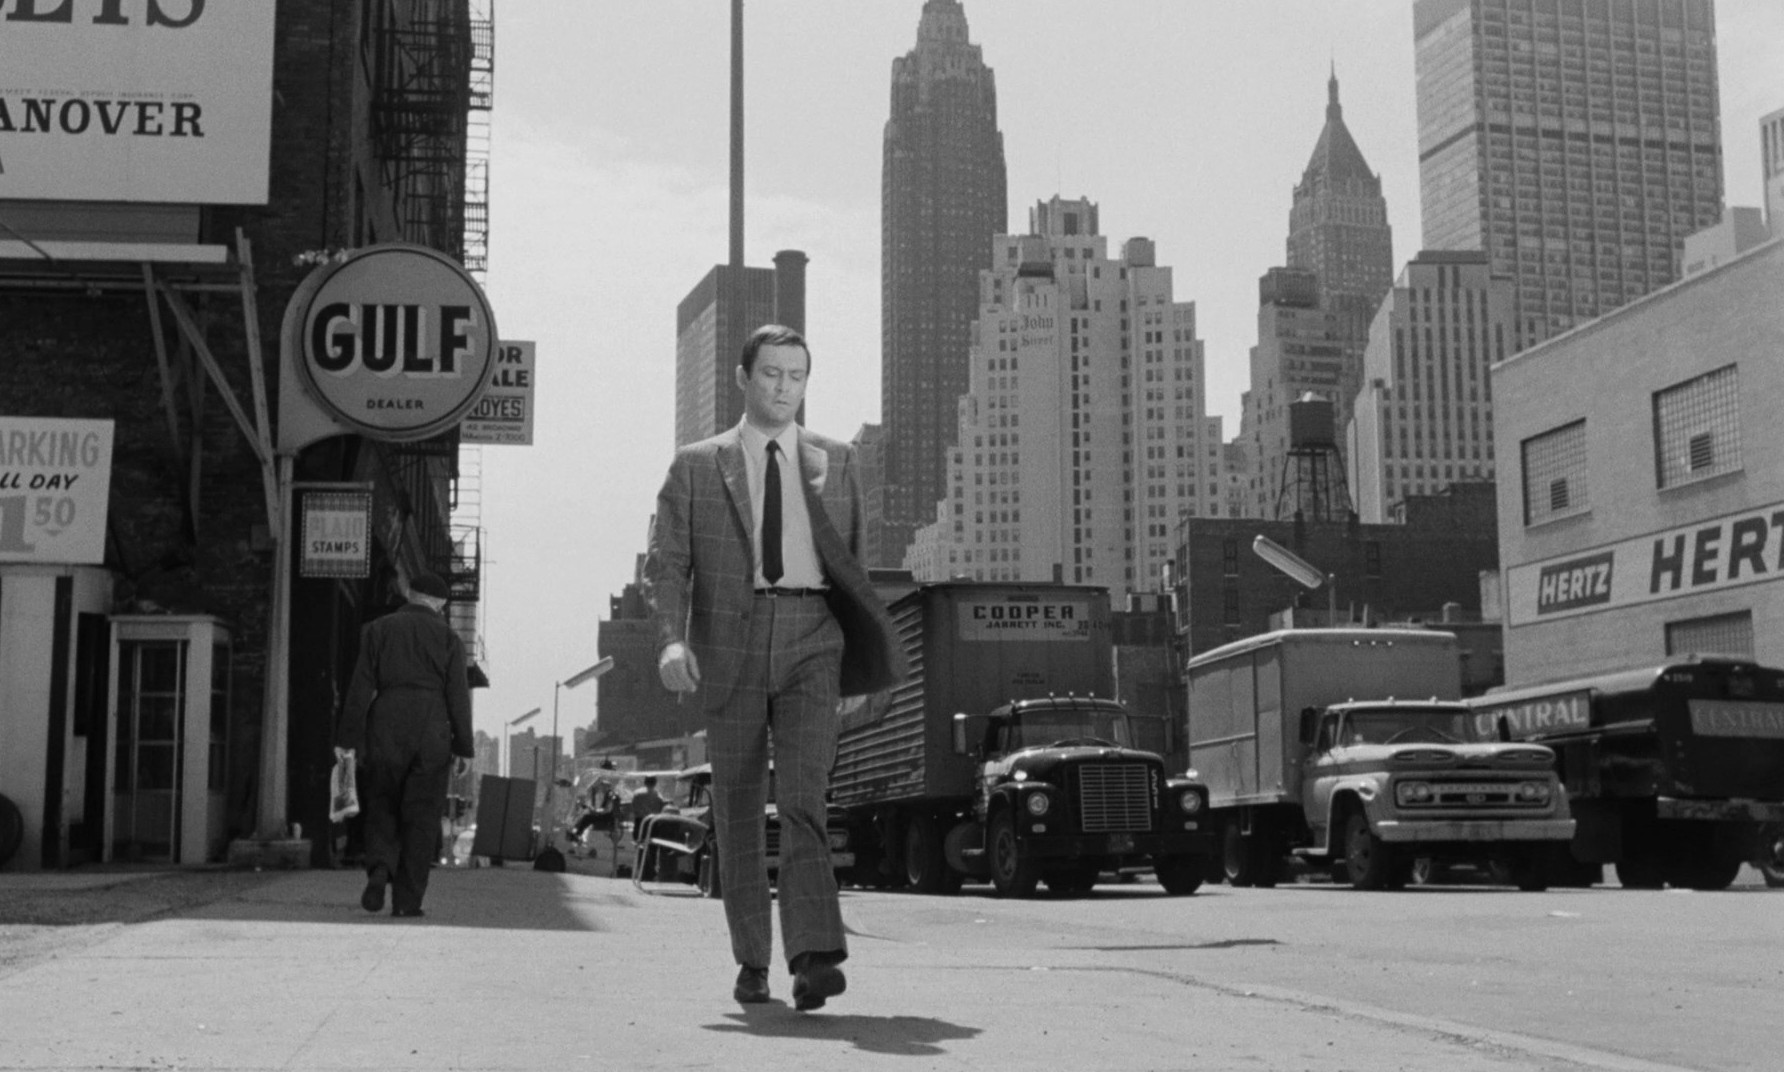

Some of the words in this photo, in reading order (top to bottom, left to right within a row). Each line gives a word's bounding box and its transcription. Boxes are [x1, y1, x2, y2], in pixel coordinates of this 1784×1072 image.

[312, 303, 470, 372] GULF
[366, 399, 424, 410] DEALER
[29, 473, 79, 490] DAY
[312, 541, 359, 553] STAMPS
[1541, 563, 1609, 605] HERTZ
[973, 605, 1074, 620] COOPER
